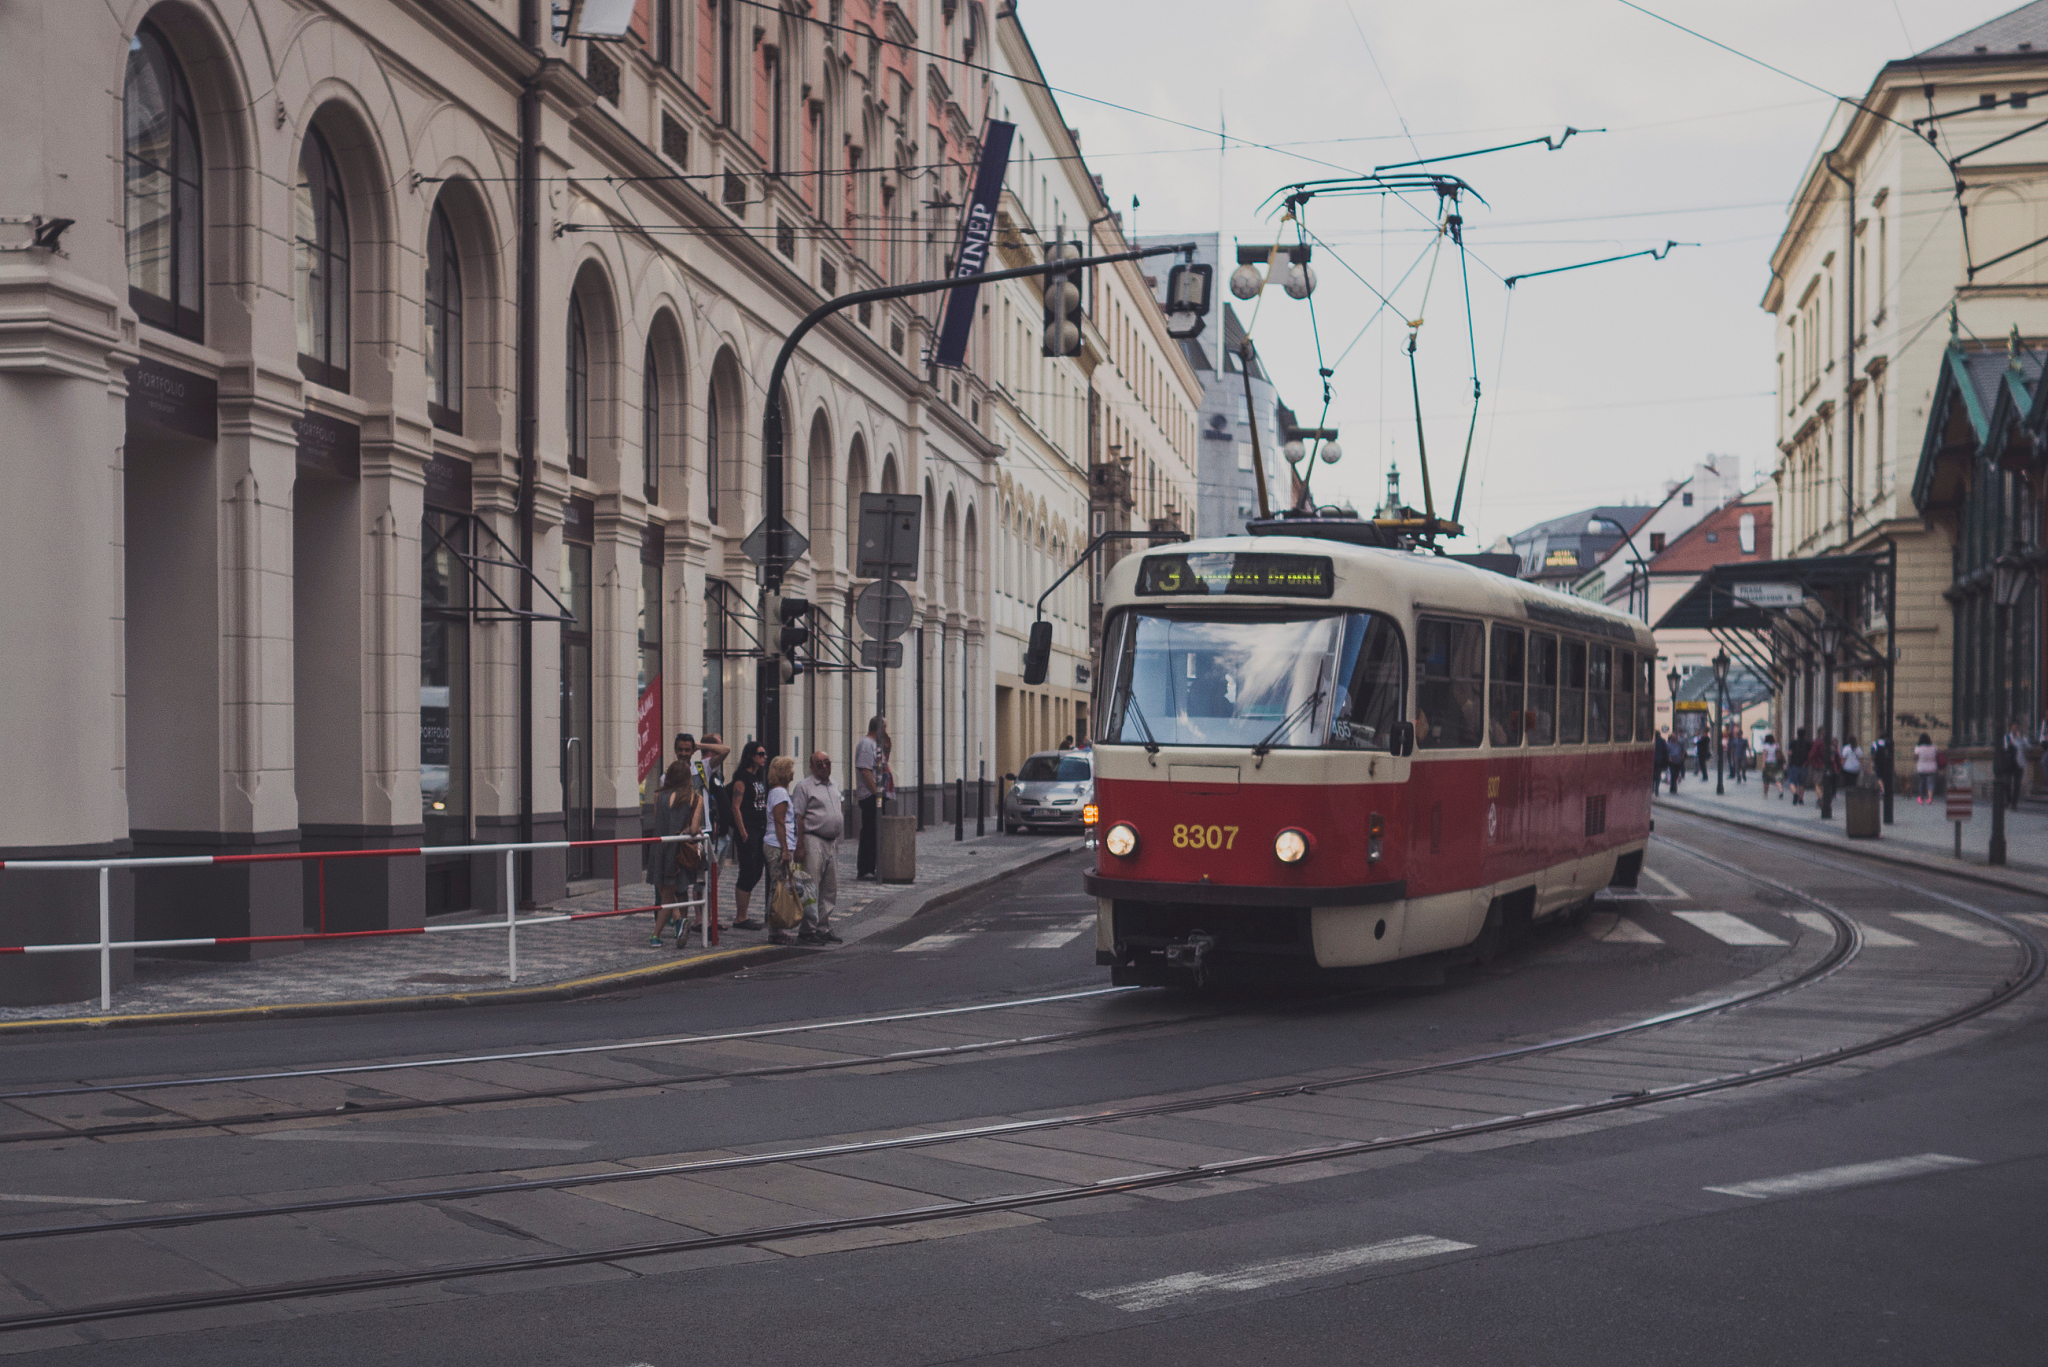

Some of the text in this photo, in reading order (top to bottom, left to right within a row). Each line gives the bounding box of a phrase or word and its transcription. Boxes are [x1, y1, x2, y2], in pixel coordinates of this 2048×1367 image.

[137, 370, 185, 397] PORTFOLIO
[298, 421, 336, 443] PORTFOLIO
[1158, 562, 1180, 591] 3
[420, 726, 450, 738] PORTFOLIO
[1172, 824, 1239, 850] 8307
